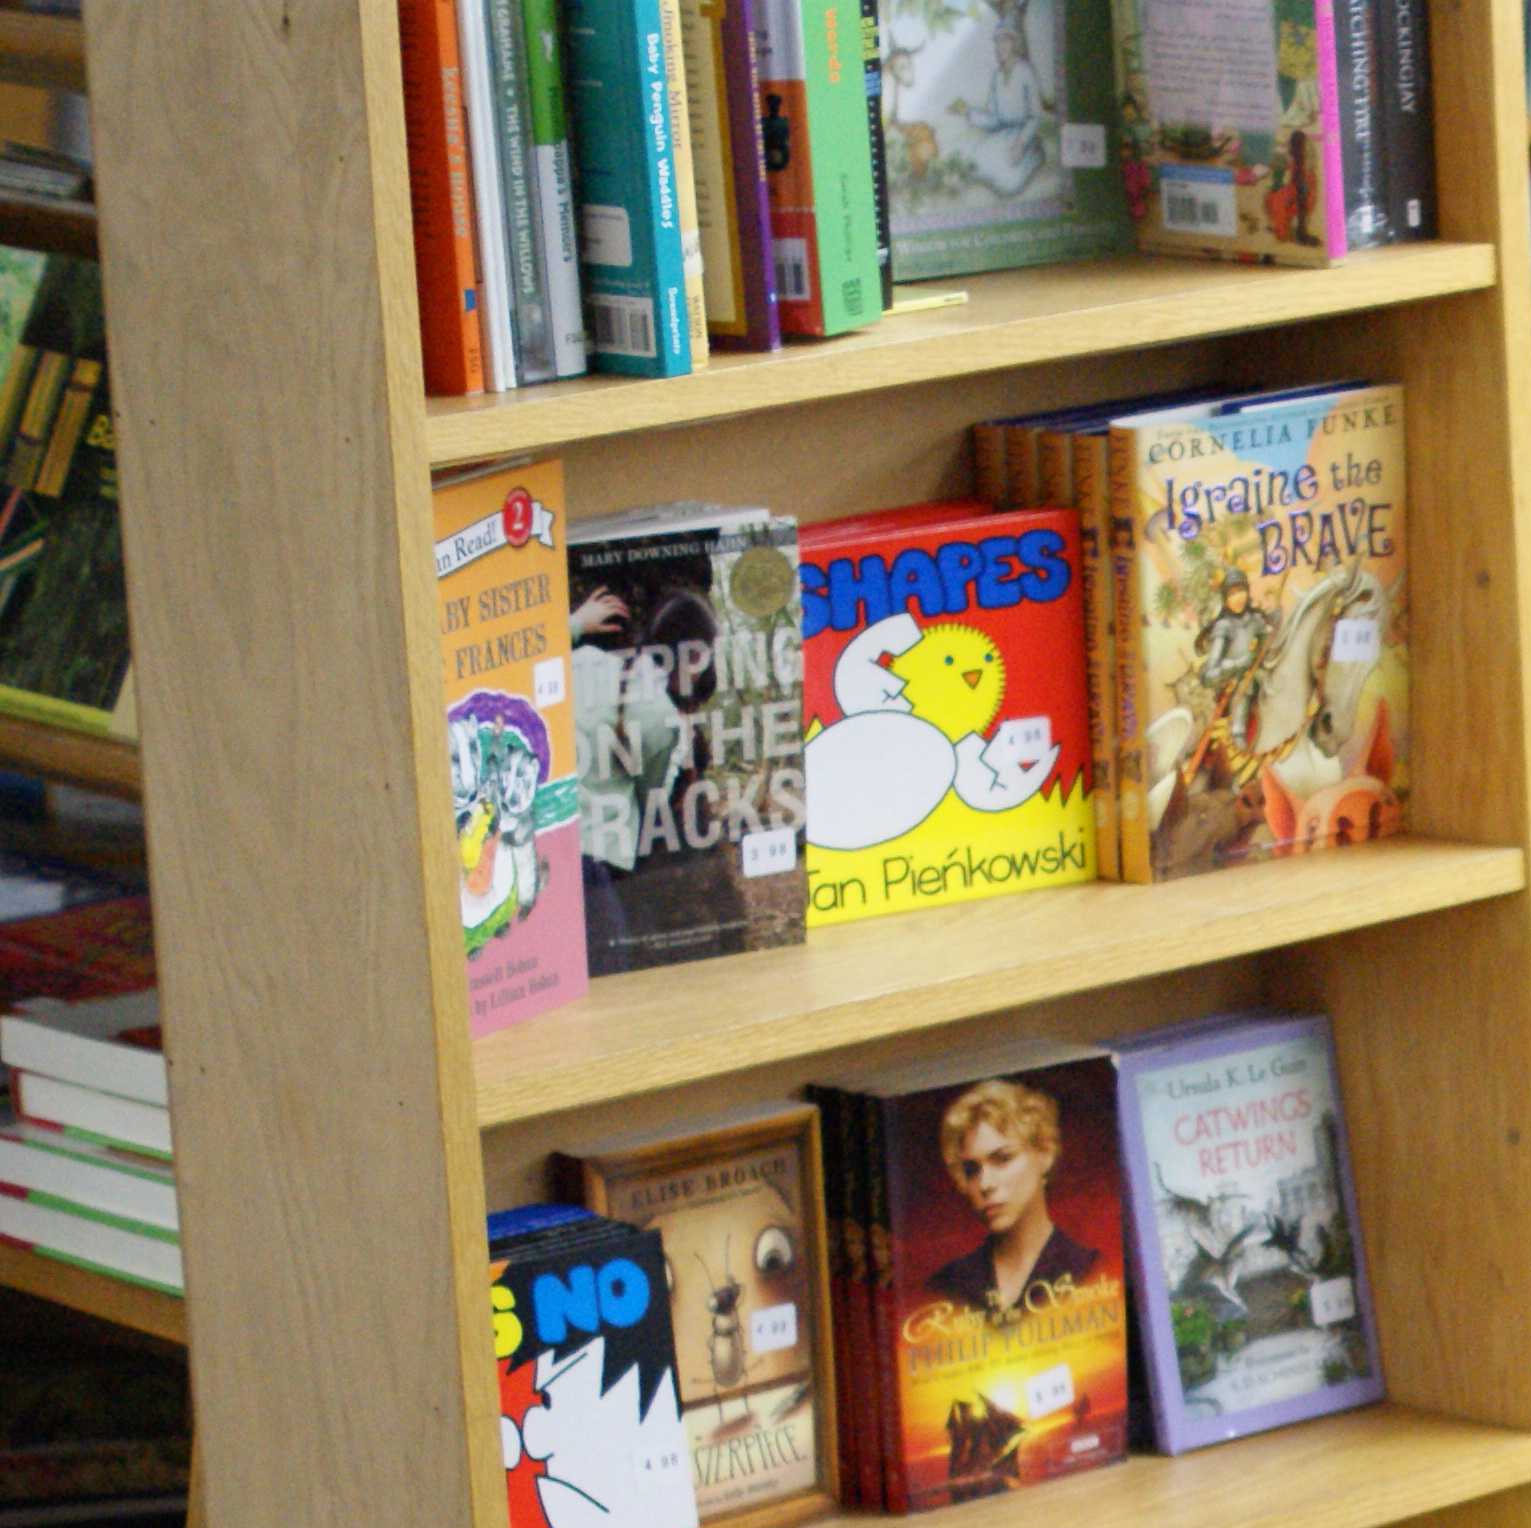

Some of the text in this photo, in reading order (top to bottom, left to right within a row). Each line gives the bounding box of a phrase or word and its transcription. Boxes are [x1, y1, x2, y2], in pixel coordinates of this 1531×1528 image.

[1396, 0, 1416, 113] OCKINGJAY
[646, 32, 674, 230] Baby Penguin Waddles
[1147, 424, 1294, 466] CORNELIA
[1307, 403, 1399, 439] FUNKE
[511, 500, 525, 530] 2
[1165, 452, 1384, 541] Igraine the
[453, 518, 498, 562] Read!
[581, 550, 623, 569] MARY
[626, 541, 699, 563] DOWNING
[1256, 496, 1397, 578] BRAVE
[478, 573, 551, 623] SISTER
[799, 528, 1071, 641] SHAPES
[454, 622, 547, 680] FRANCES
[665, 701, 802, 769] THE
[883, 826, 1086, 900] Pieńkowski
[1168, 1070, 1221, 1099] Ursula
[1174, 1088, 1313, 1147] CATWINGS
[1199, 1129, 1298, 1177] RETURN
[531, 1256, 653, 1346] NO
[1003, 1300, 1119, 1354] PULLMAN
